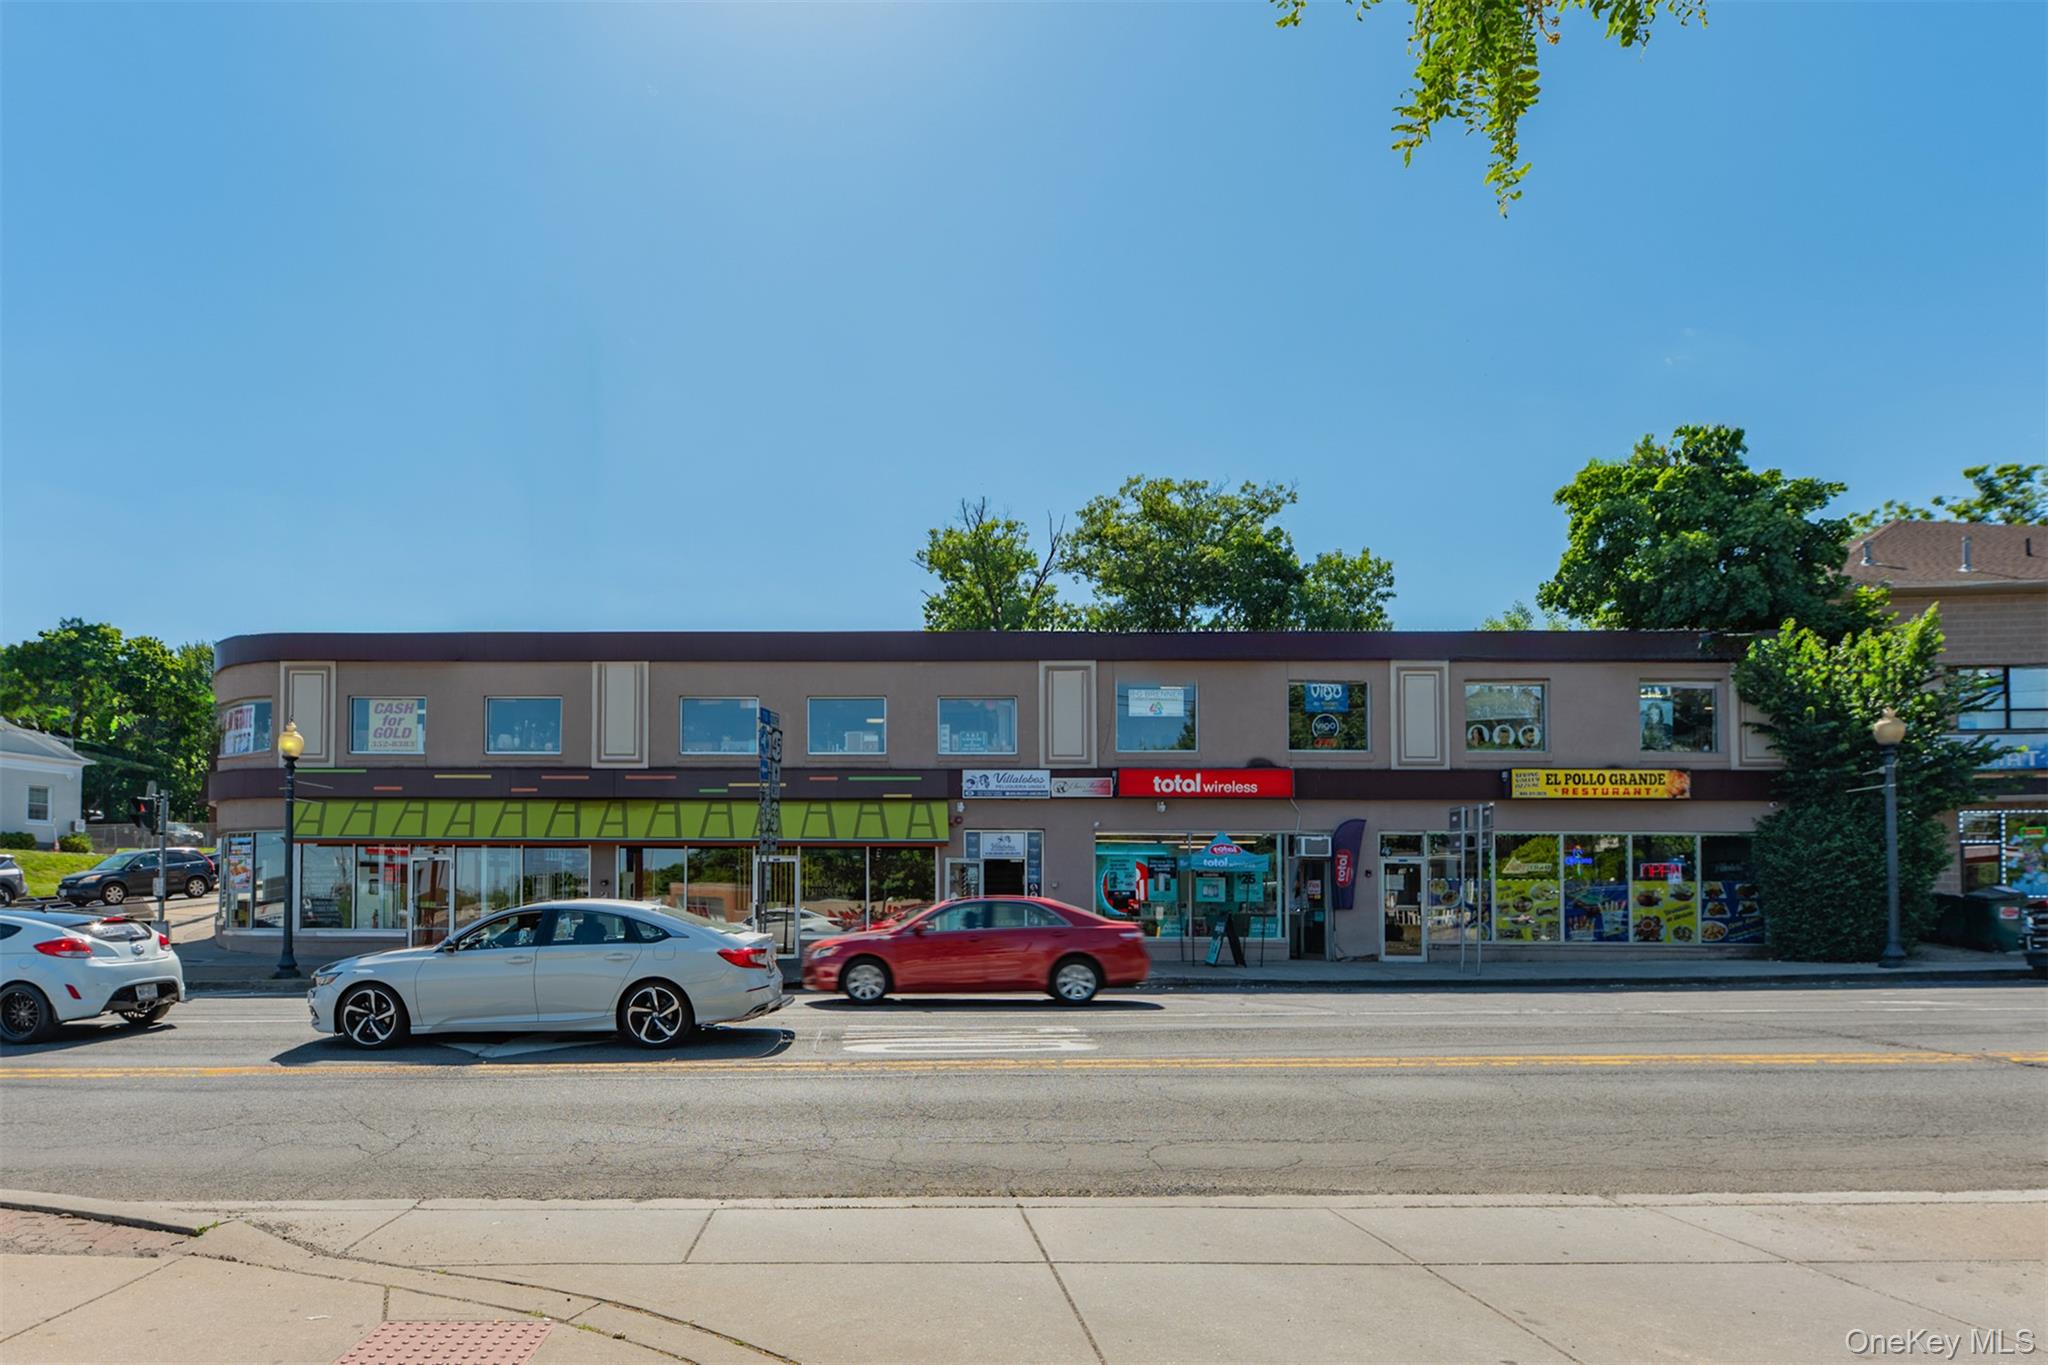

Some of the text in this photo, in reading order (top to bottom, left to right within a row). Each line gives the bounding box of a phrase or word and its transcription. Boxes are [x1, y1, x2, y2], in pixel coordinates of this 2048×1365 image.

[374, 703, 415, 714] CASH
[382, 714, 405, 727] for
[373, 727, 413, 739] GOLD
[994, 772, 1046, 784] Villalobos
[1153, 772, 1258, 793] total wireless
[1545, 773, 1666, 785] EL POLLO GRANDE
[1561, 787, 1652, 796] RESTURANT
[1212, 845, 1238, 853] total
[1203, 857, 1228, 868] total
[1337, 854, 1348, 882] total
